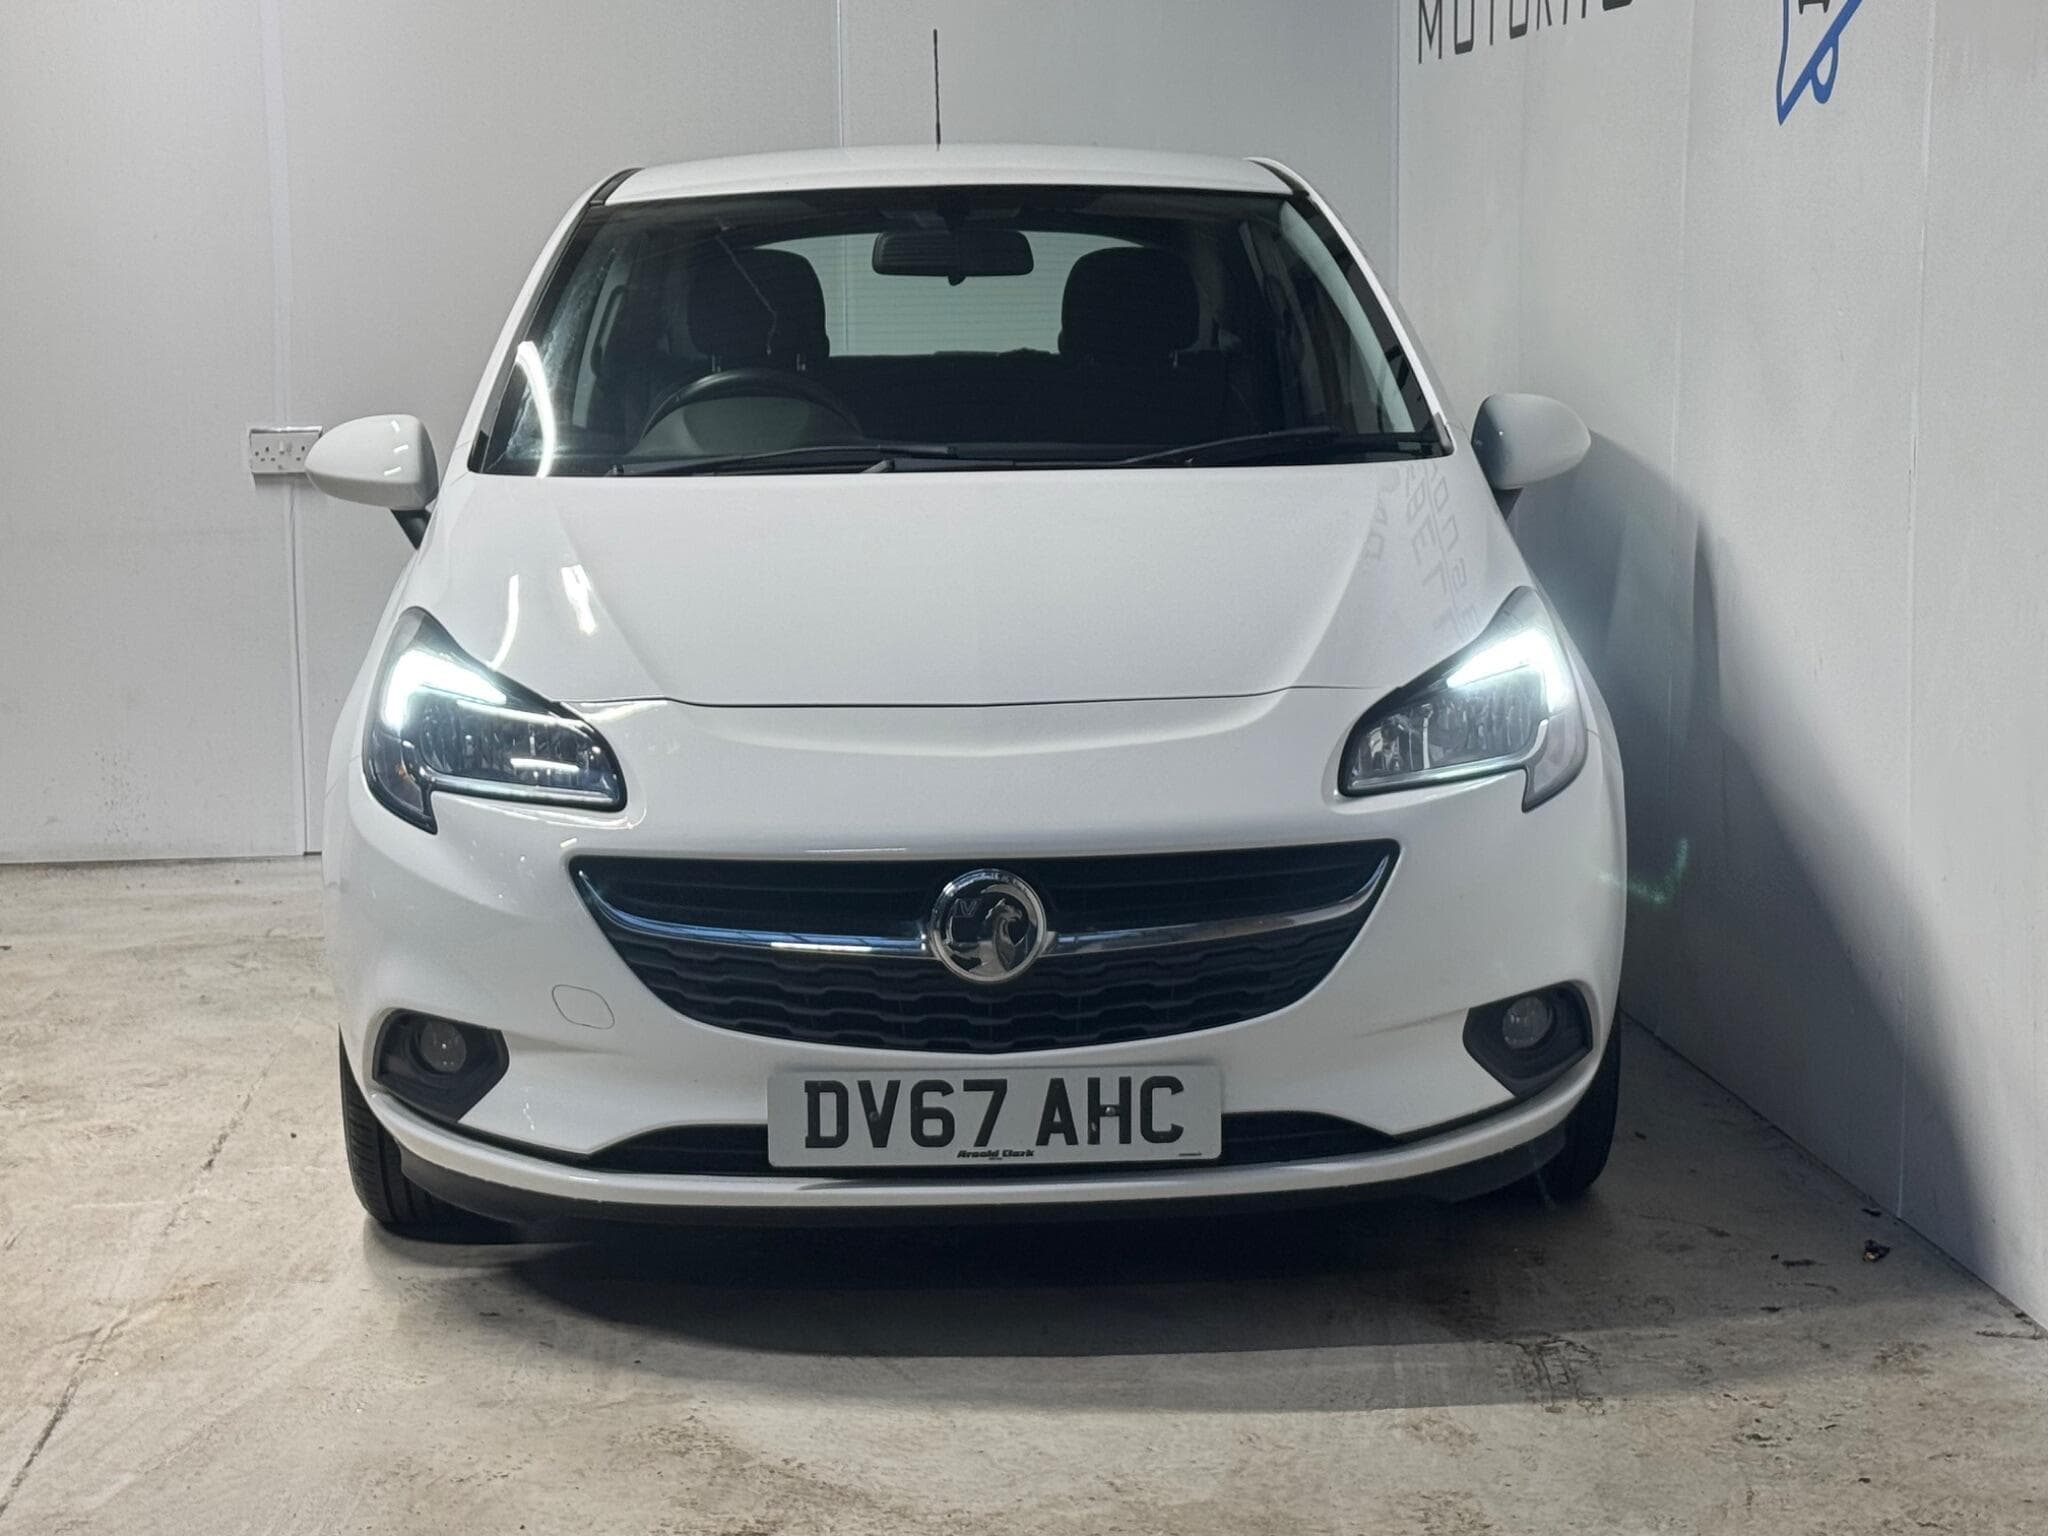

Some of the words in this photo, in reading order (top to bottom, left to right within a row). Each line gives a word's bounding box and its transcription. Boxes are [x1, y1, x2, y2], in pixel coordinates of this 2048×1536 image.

[804, 1078, 1008, 1149] DV67
[1035, 1075, 1185, 1147] AHC
[1002, 1149, 1035, 1158] Clark
